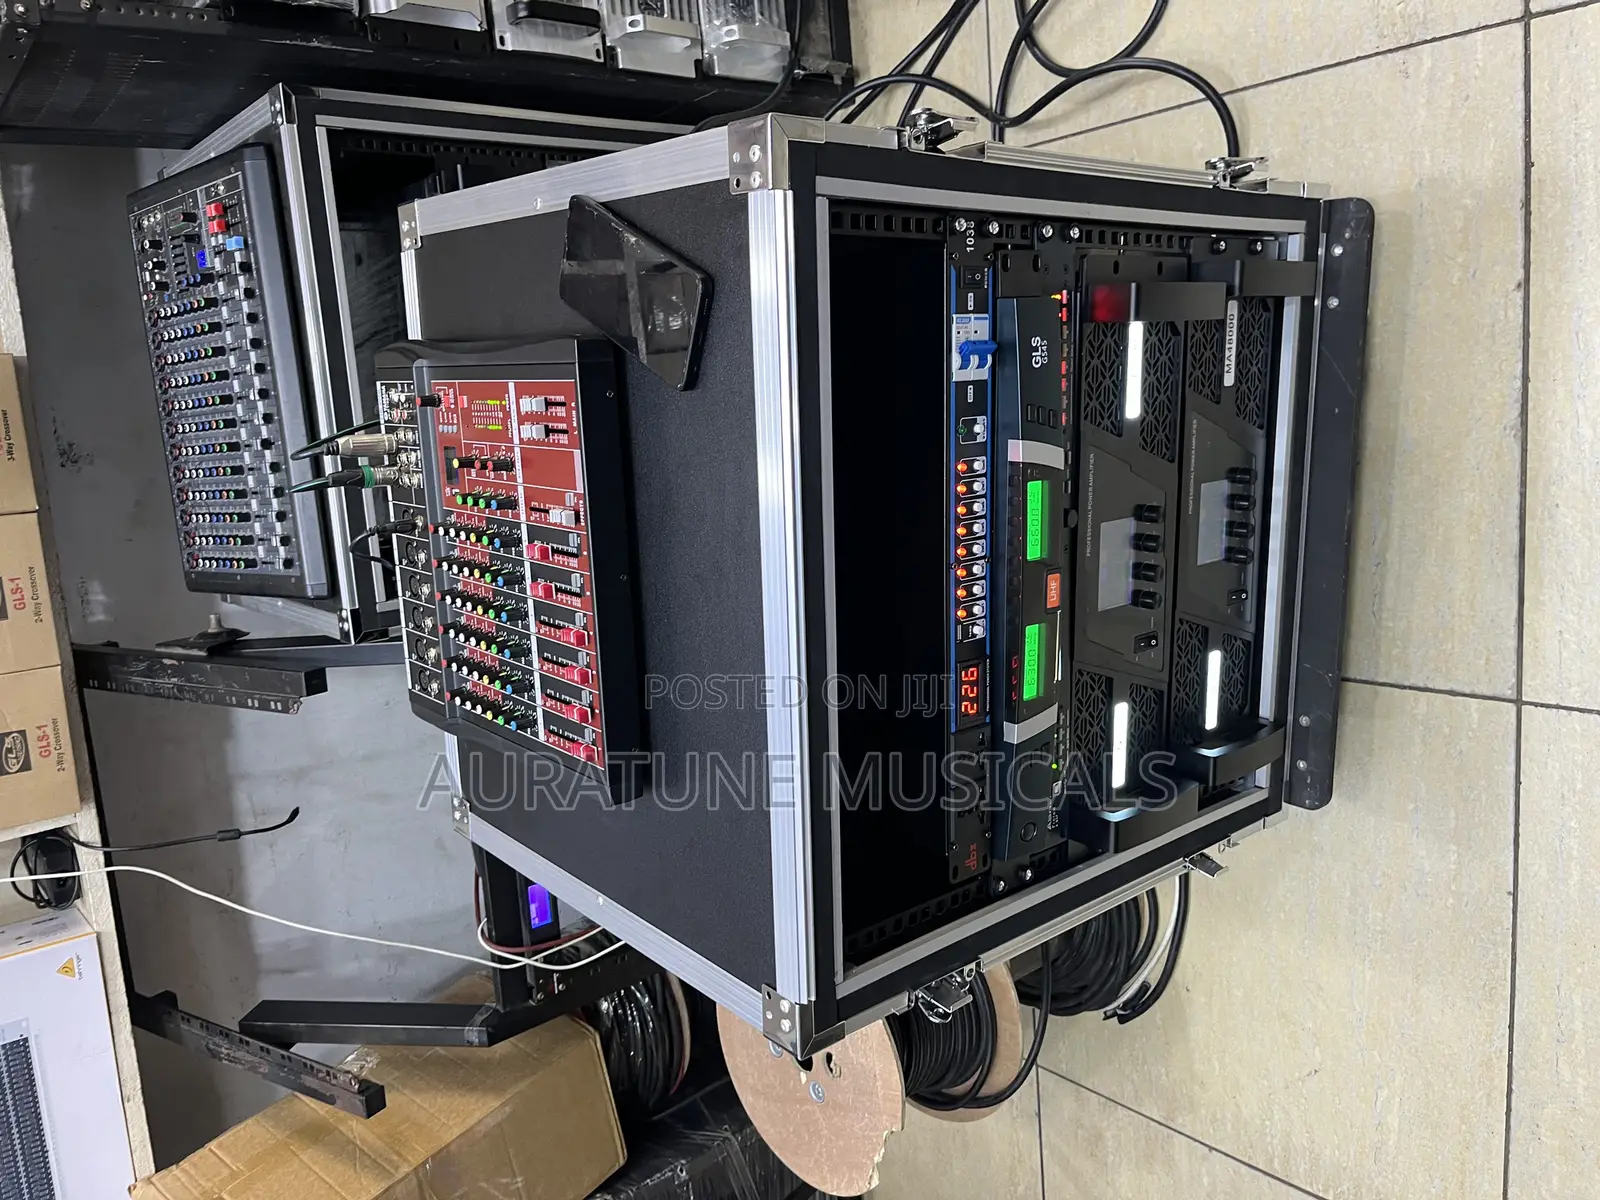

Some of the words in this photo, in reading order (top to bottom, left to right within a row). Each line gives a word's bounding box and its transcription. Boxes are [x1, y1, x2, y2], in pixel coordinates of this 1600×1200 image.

[966, 220, 975, 253] 1038
[1031, 336, 1042, 368] GLS
[1225, 313, 1235, 375] MA48000
[1, 409, 12, 441] Crossover
[4, 440, 15, 462] 3-Way
[8, 576, 27, 611] GLS-1
[27, 566, 40, 600] Crossover
[1050, 580, 1058, 601] UHF
[33, 602, 43, 623] 2-Way
[961, 667, 978, 715] 226
[36, 723, 52, 759] GLS-1
[51, 718, 63, 751] Crossover
[56, 752, 66, 772] 2-Way
[964, 843, 978, 871] dbx
